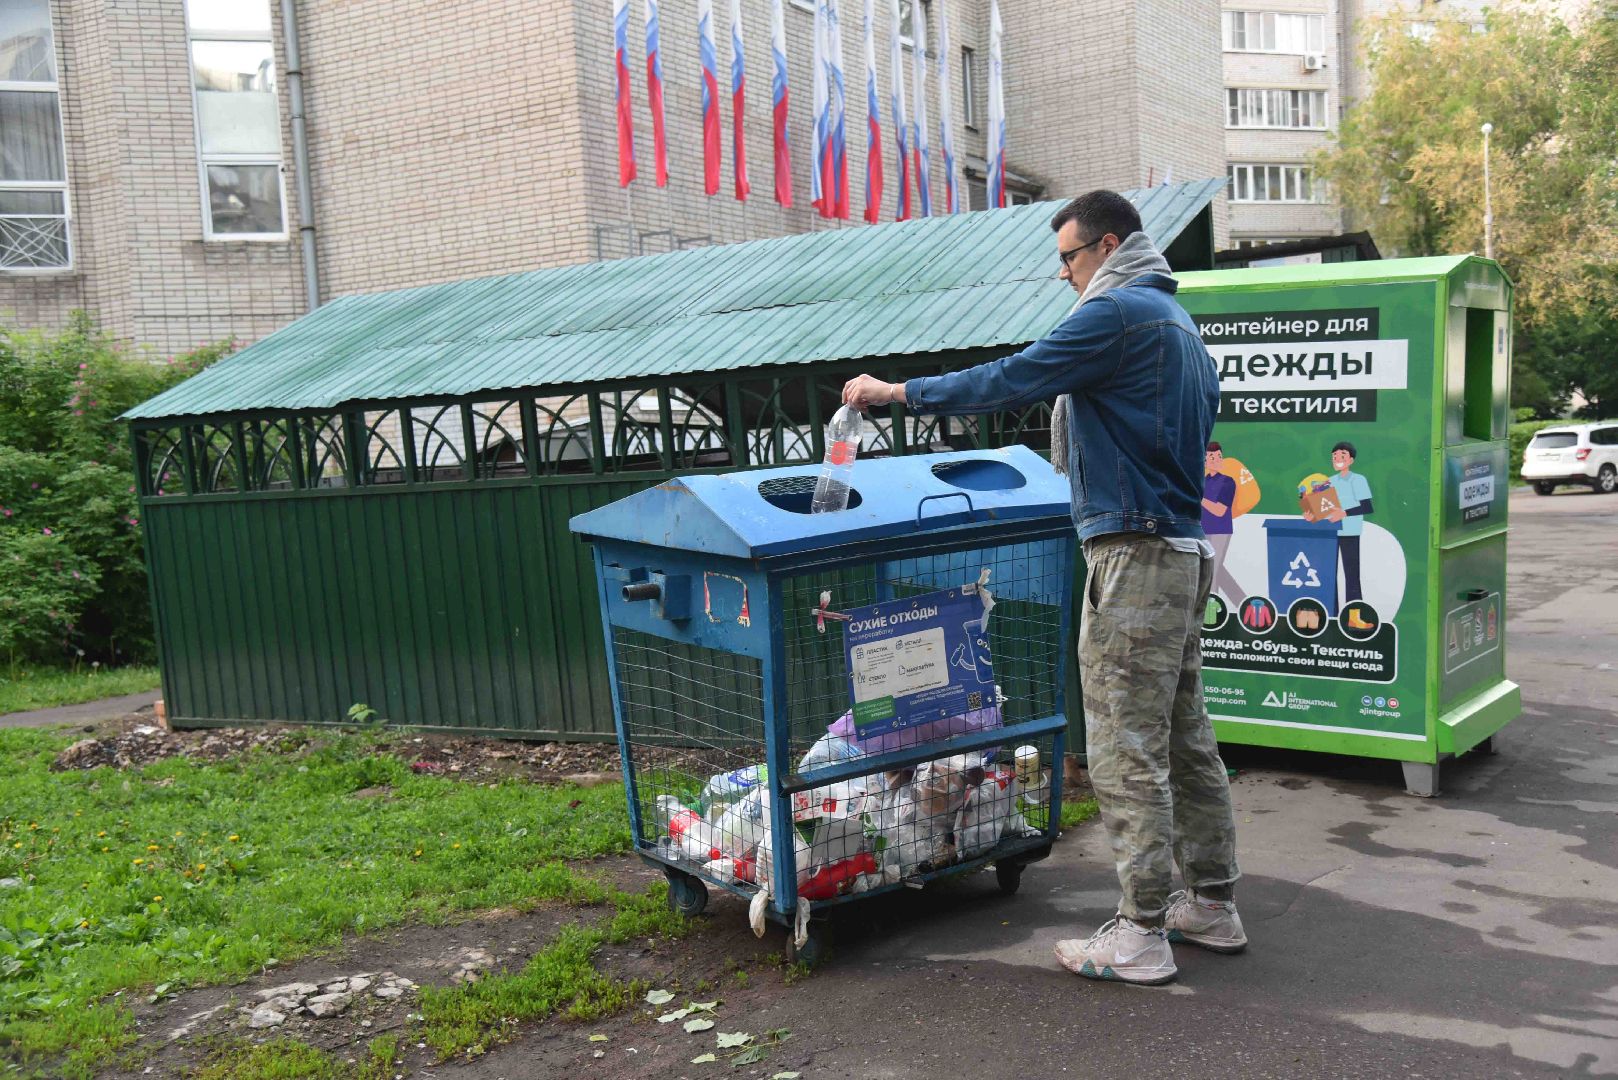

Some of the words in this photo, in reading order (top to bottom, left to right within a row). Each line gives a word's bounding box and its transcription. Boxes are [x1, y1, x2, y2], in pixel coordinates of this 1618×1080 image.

[1200, 316, 1320, 337] контейнер
[1325, 317, 1369, 335] для
[1211, 351, 1373, 382] дежды
[1230, 397, 1358, 414] текстиля
[849, 616, 888, 634] СУХИЕ
[889, 605, 938, 625] ОТХОДЫ
[1251, 640, 1298, 655] Обувь
[1310, 644, 1384, 660] Текстиль
[1200, 650, 1227, 659] жете
[1230, 652, 1286, 664] положить
[1287, 657, 1315, 666] свои
[1317, 659, 1350, 670] вещи
[1352, 661, 1384, 672] сюда
[1203, 696, 1247, 705] group.com
[1288, 697, 1338, 708] INTERNATIONAL
[1359, 708, 1401, 718] ajintgroup
